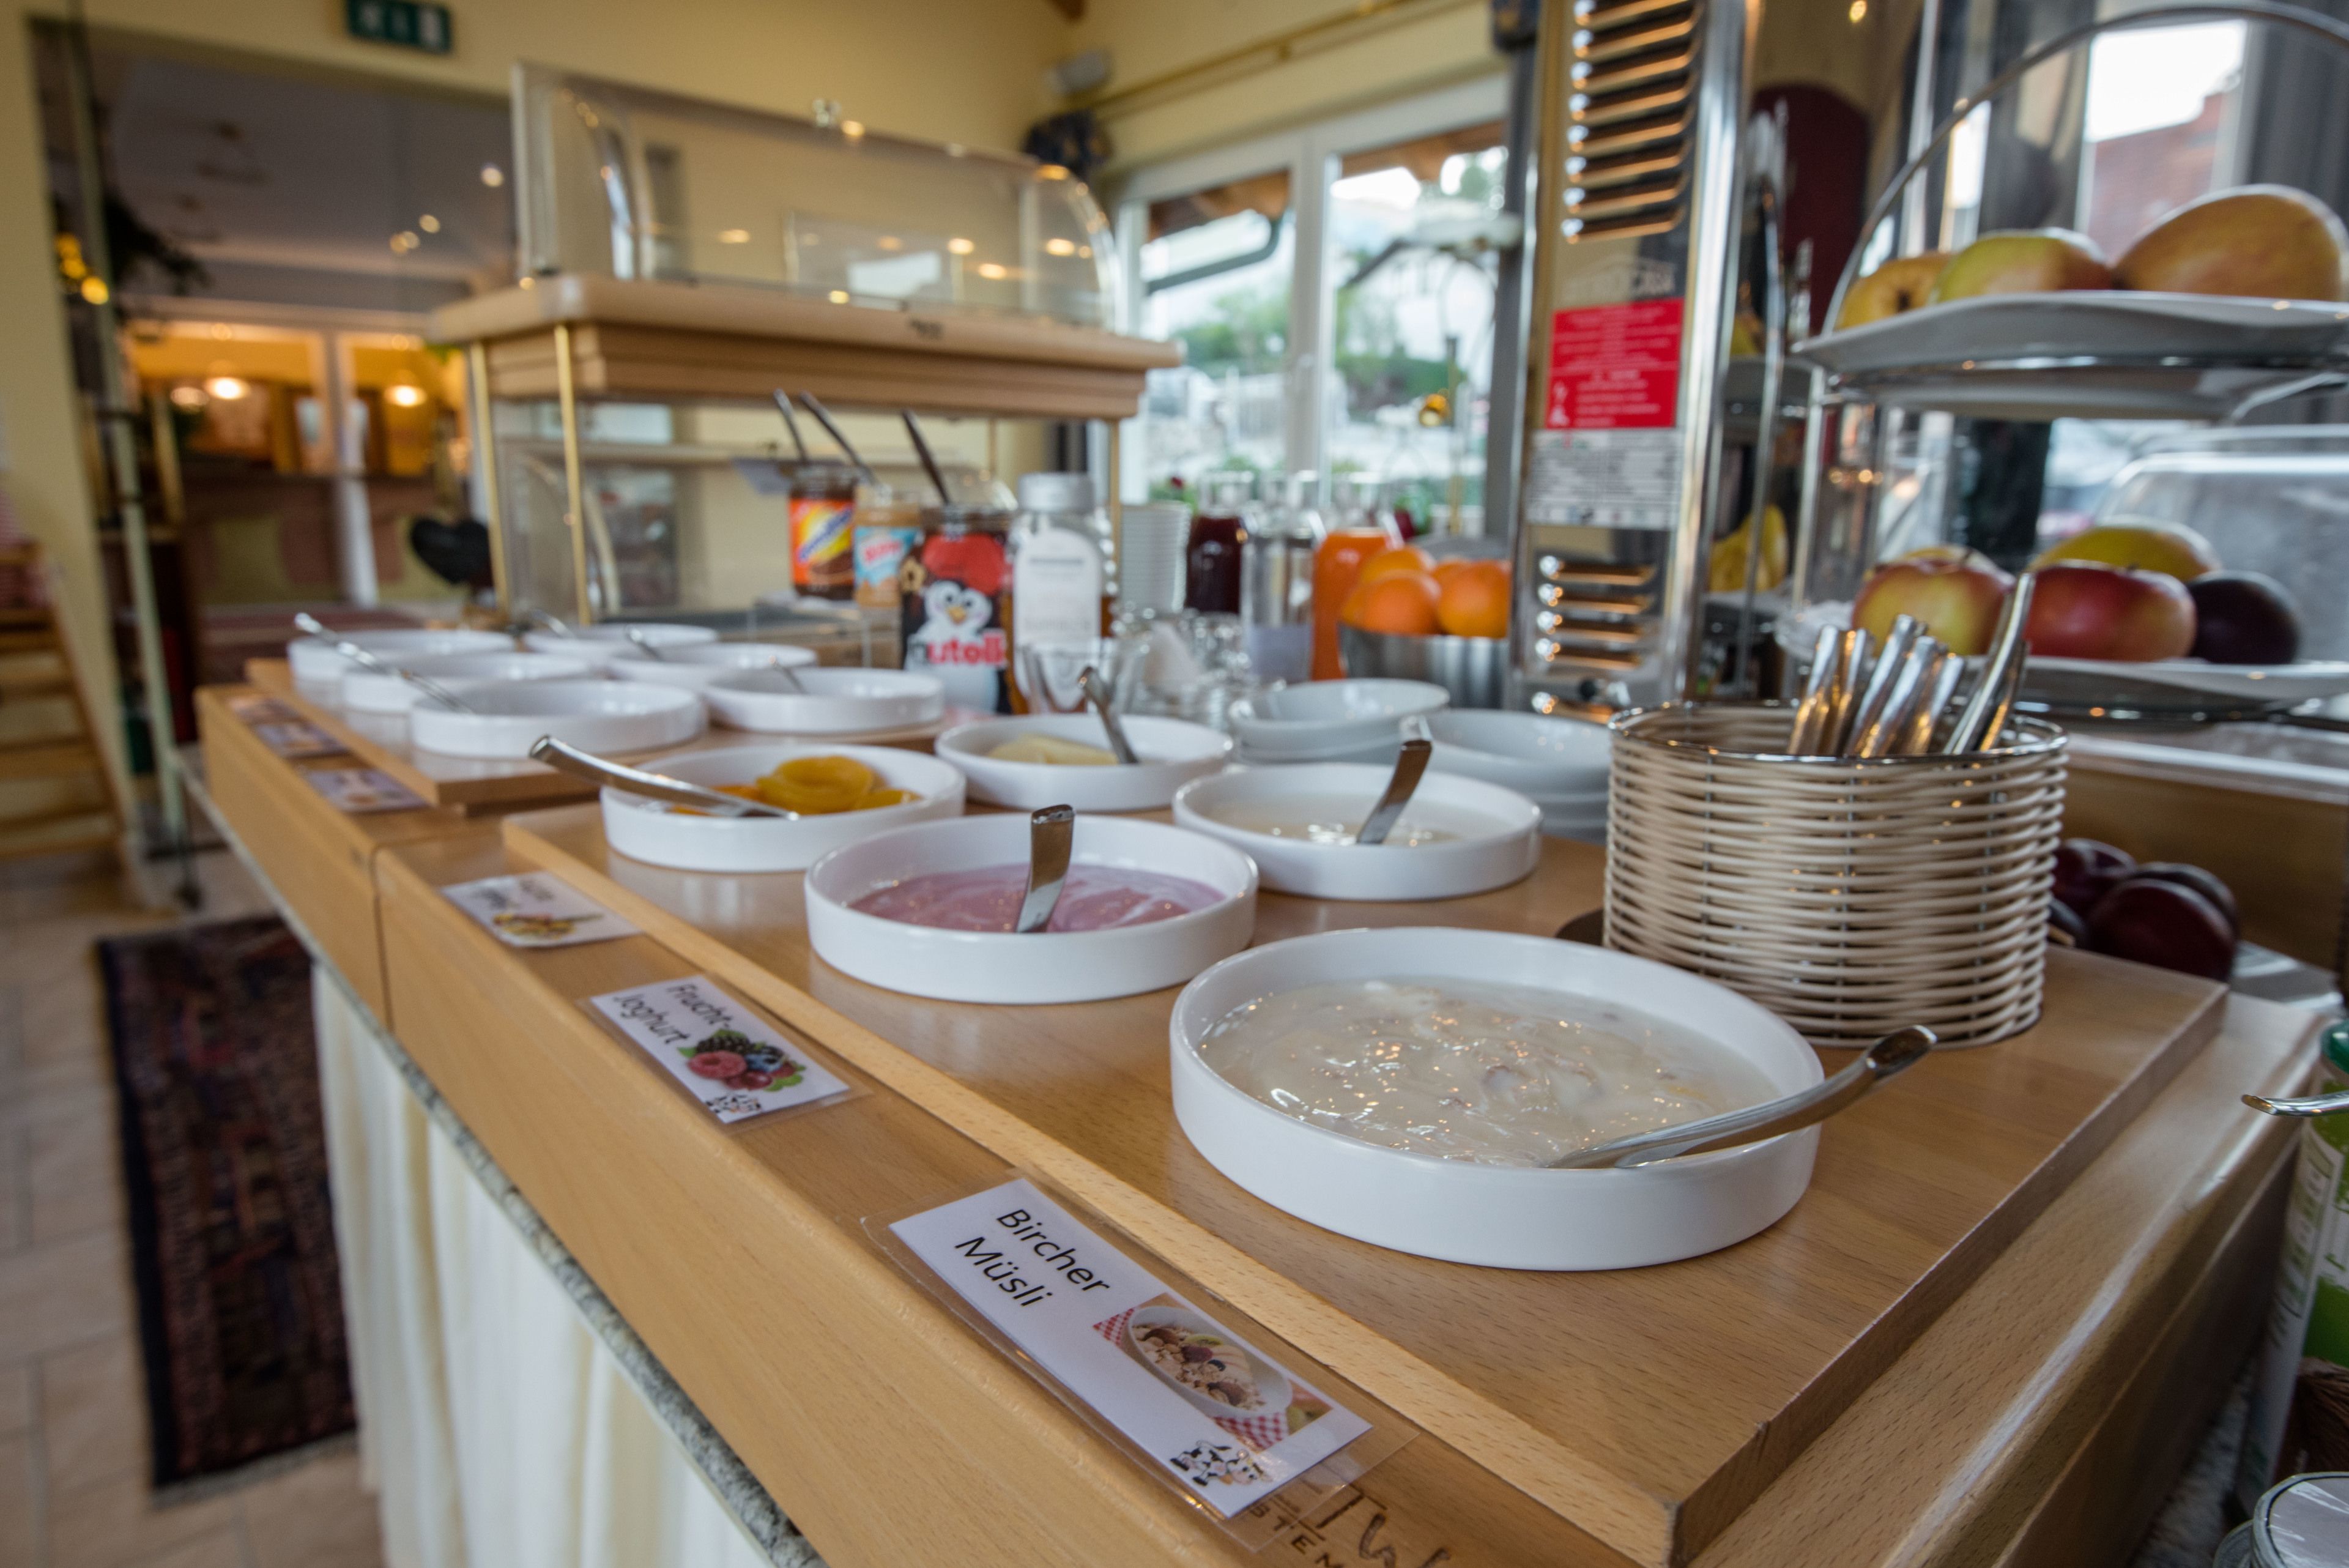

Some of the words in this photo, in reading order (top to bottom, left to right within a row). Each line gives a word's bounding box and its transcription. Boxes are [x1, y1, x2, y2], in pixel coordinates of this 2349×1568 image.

[613, 994, 690, 1044] Joghurt
[954, 1236, 1053, 1306] Müsli
[996, 1209, 1110, 1291] Bircher
